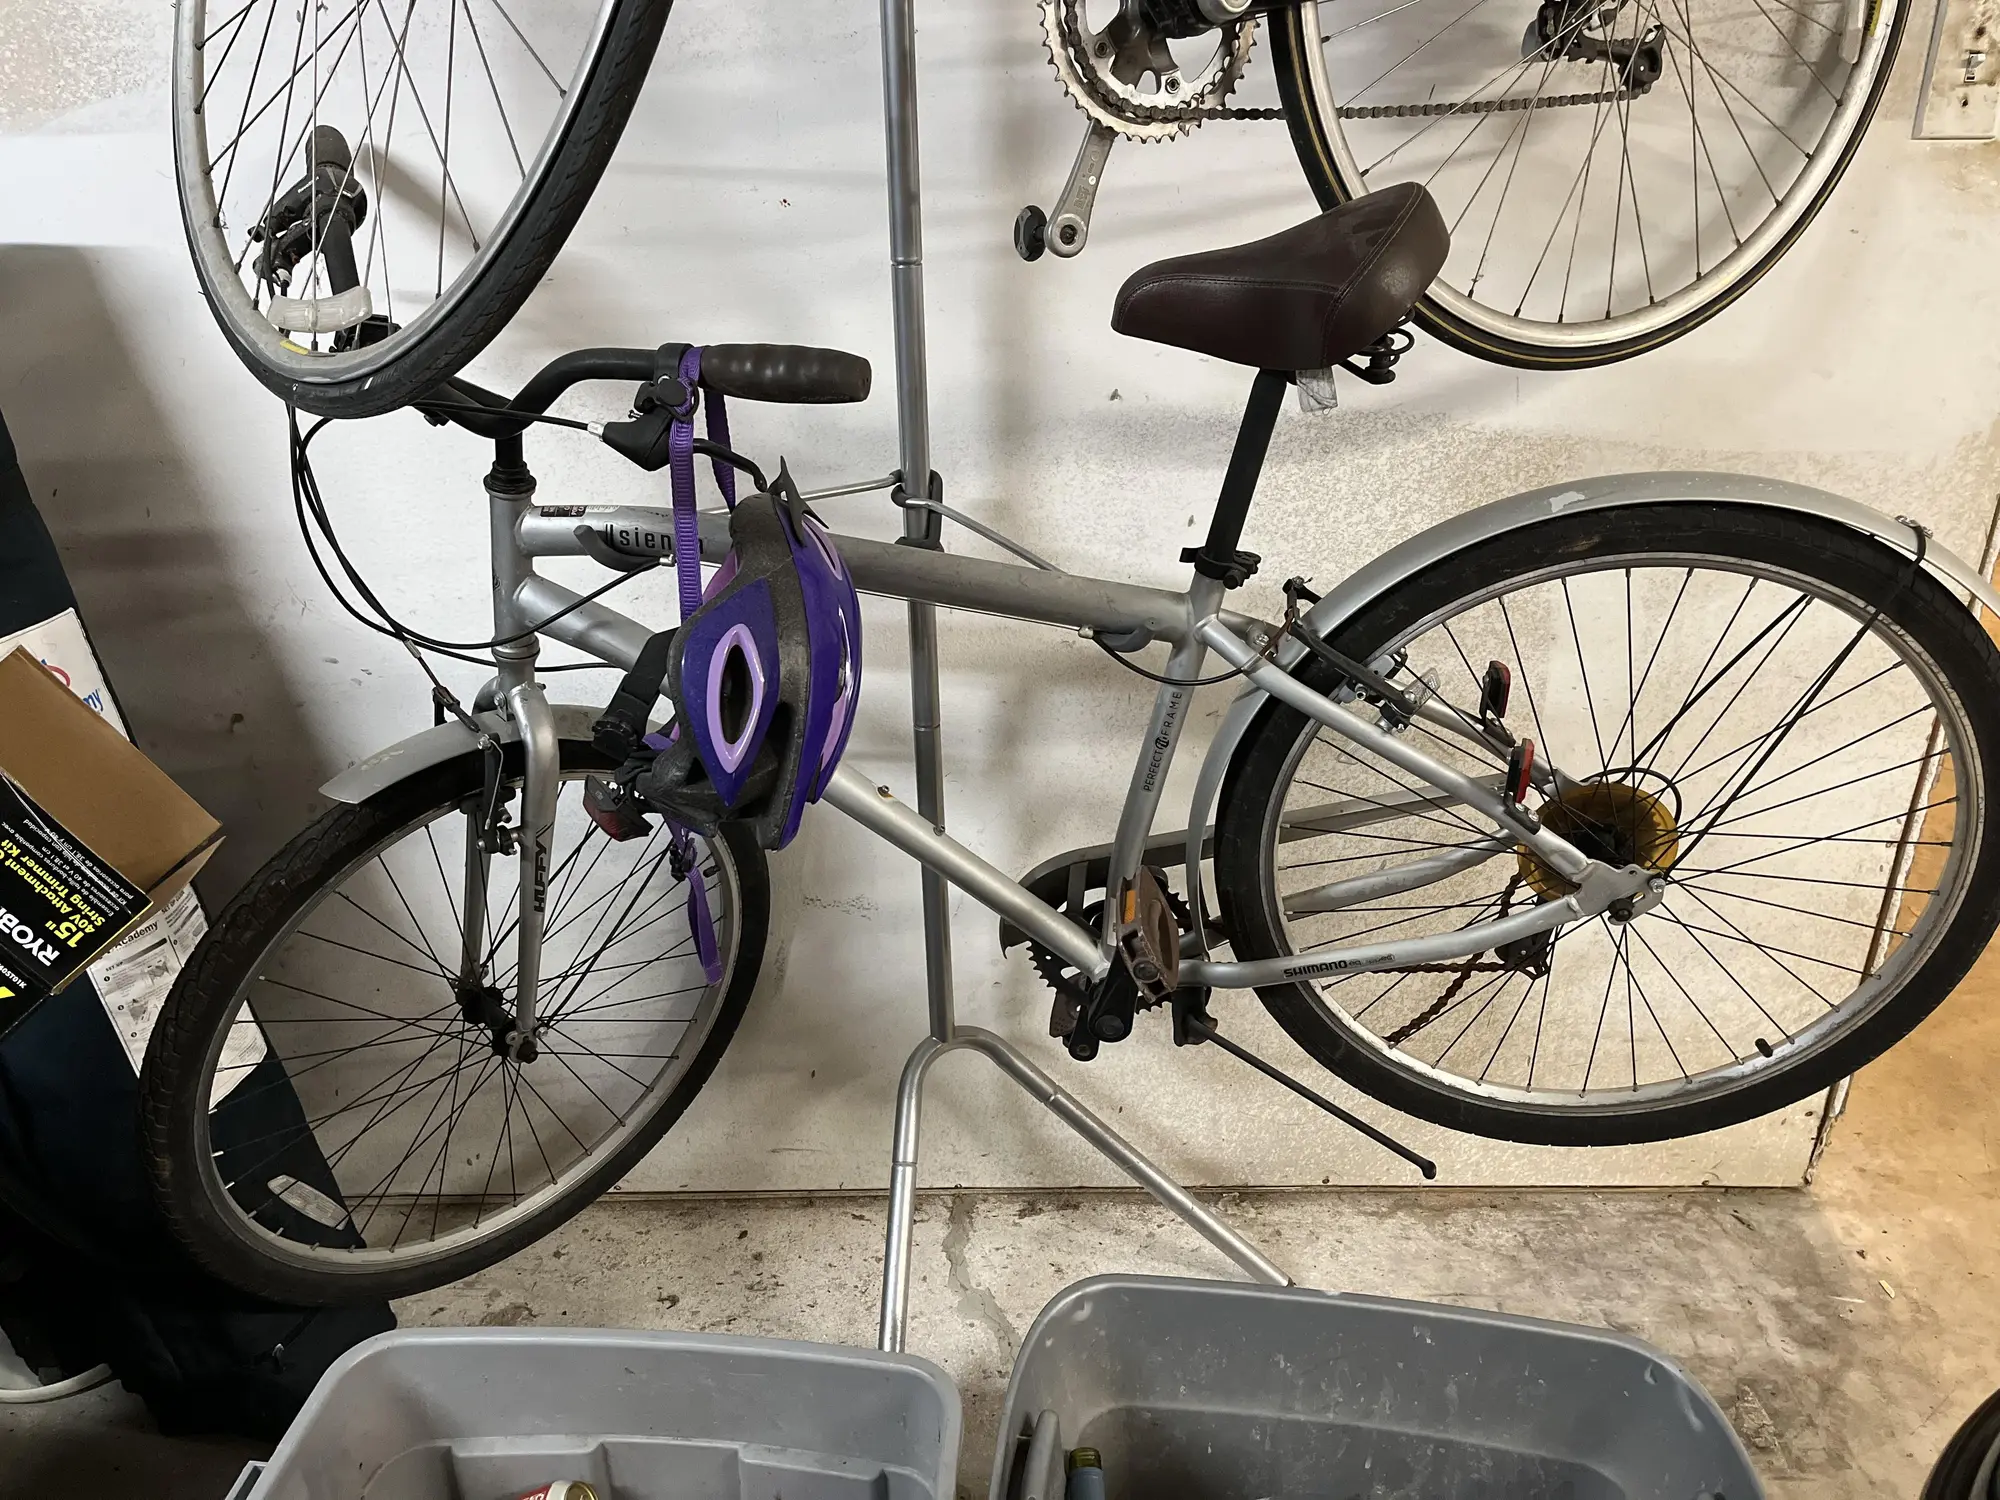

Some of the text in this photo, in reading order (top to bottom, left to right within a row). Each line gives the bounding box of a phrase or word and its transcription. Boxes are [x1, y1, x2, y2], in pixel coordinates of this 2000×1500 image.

[619, 526, 704, 555] sien
[1161, 692, 1182, 737] FRAME
[1143, 750, 1164, 792] PERFECT
[1, 820, 15, 833] avec
[22, 818, 52, 842] capacidad
[13, 832, 44, 857] compatible
[41, 845, 51, 854] cm
[50, 840, 63, 851] con
[50, 853, 64, 865] 38,1
[83, 858, 93, 867] de
[0, 838, 106, 925] String Trimmer Kit
[42, 856, 81, 889] taille-bordures
[72, 872, 83, 880] 40
[81, 879, 91, 888] de
[91, 865, 120, 889] accesorios
[534, 840, 547, 912] HUFFY
[3, 857, 95, 933] 40V Attachment
[79, 887, 89, 895] de
[90, 886, 120, 911] accessoires
[119, 887, 134, 899] para
[87, 893, 114, 916] Ensemble
[44, 920, 85, 947] 15"
[115, 921, 158, 949] cademy
[1283, 960, 1348, 978] SHIMANO
